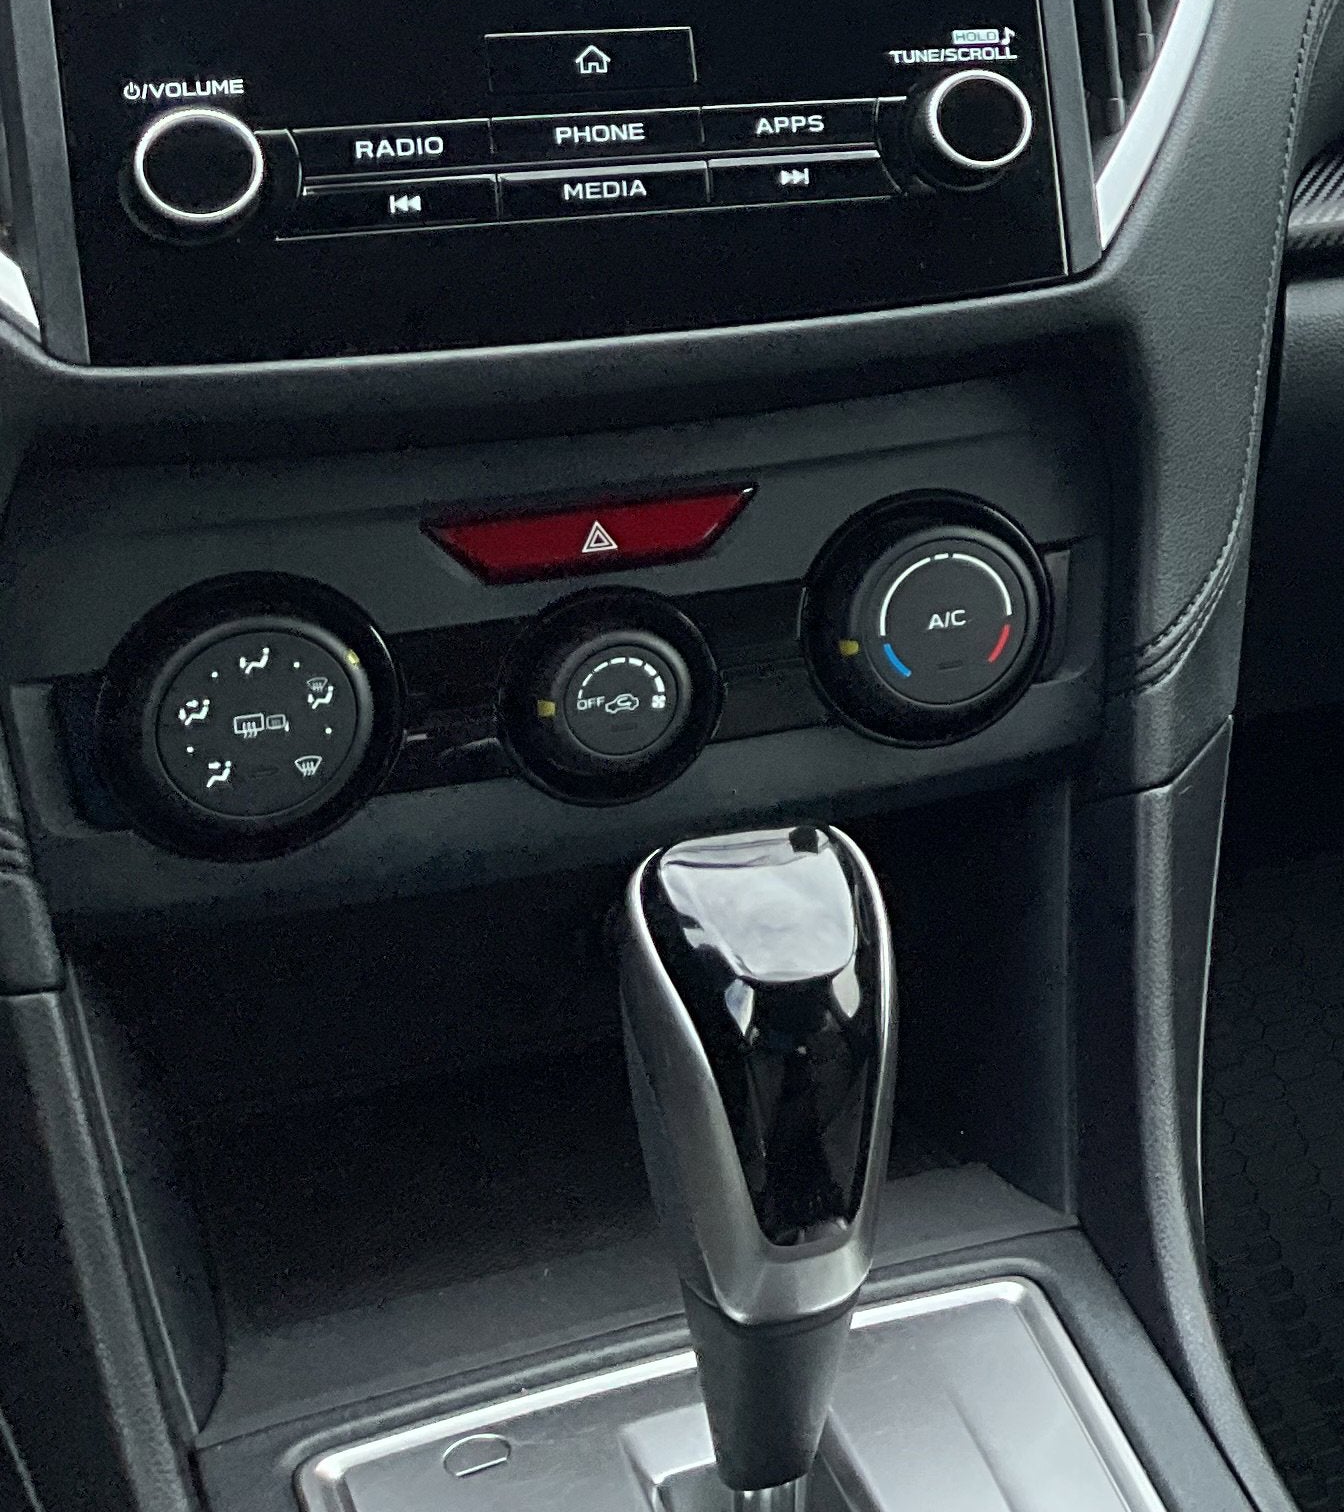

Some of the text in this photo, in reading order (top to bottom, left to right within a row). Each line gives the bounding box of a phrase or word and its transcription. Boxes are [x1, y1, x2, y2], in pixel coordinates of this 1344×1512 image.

[954, 31, 998, 42] HOLD
[889, 46, 1018, 64] TUNE/SCROLL
[555, 122, 646, 145] PHONE
[755, 114, 825, 136] APPS
[354, 135, 445, 160] RADIO
[562, 178, 648, 201] MEDIA
[928, 609, 967, 630] A/C
[577, 695, 606, 711] OFF
